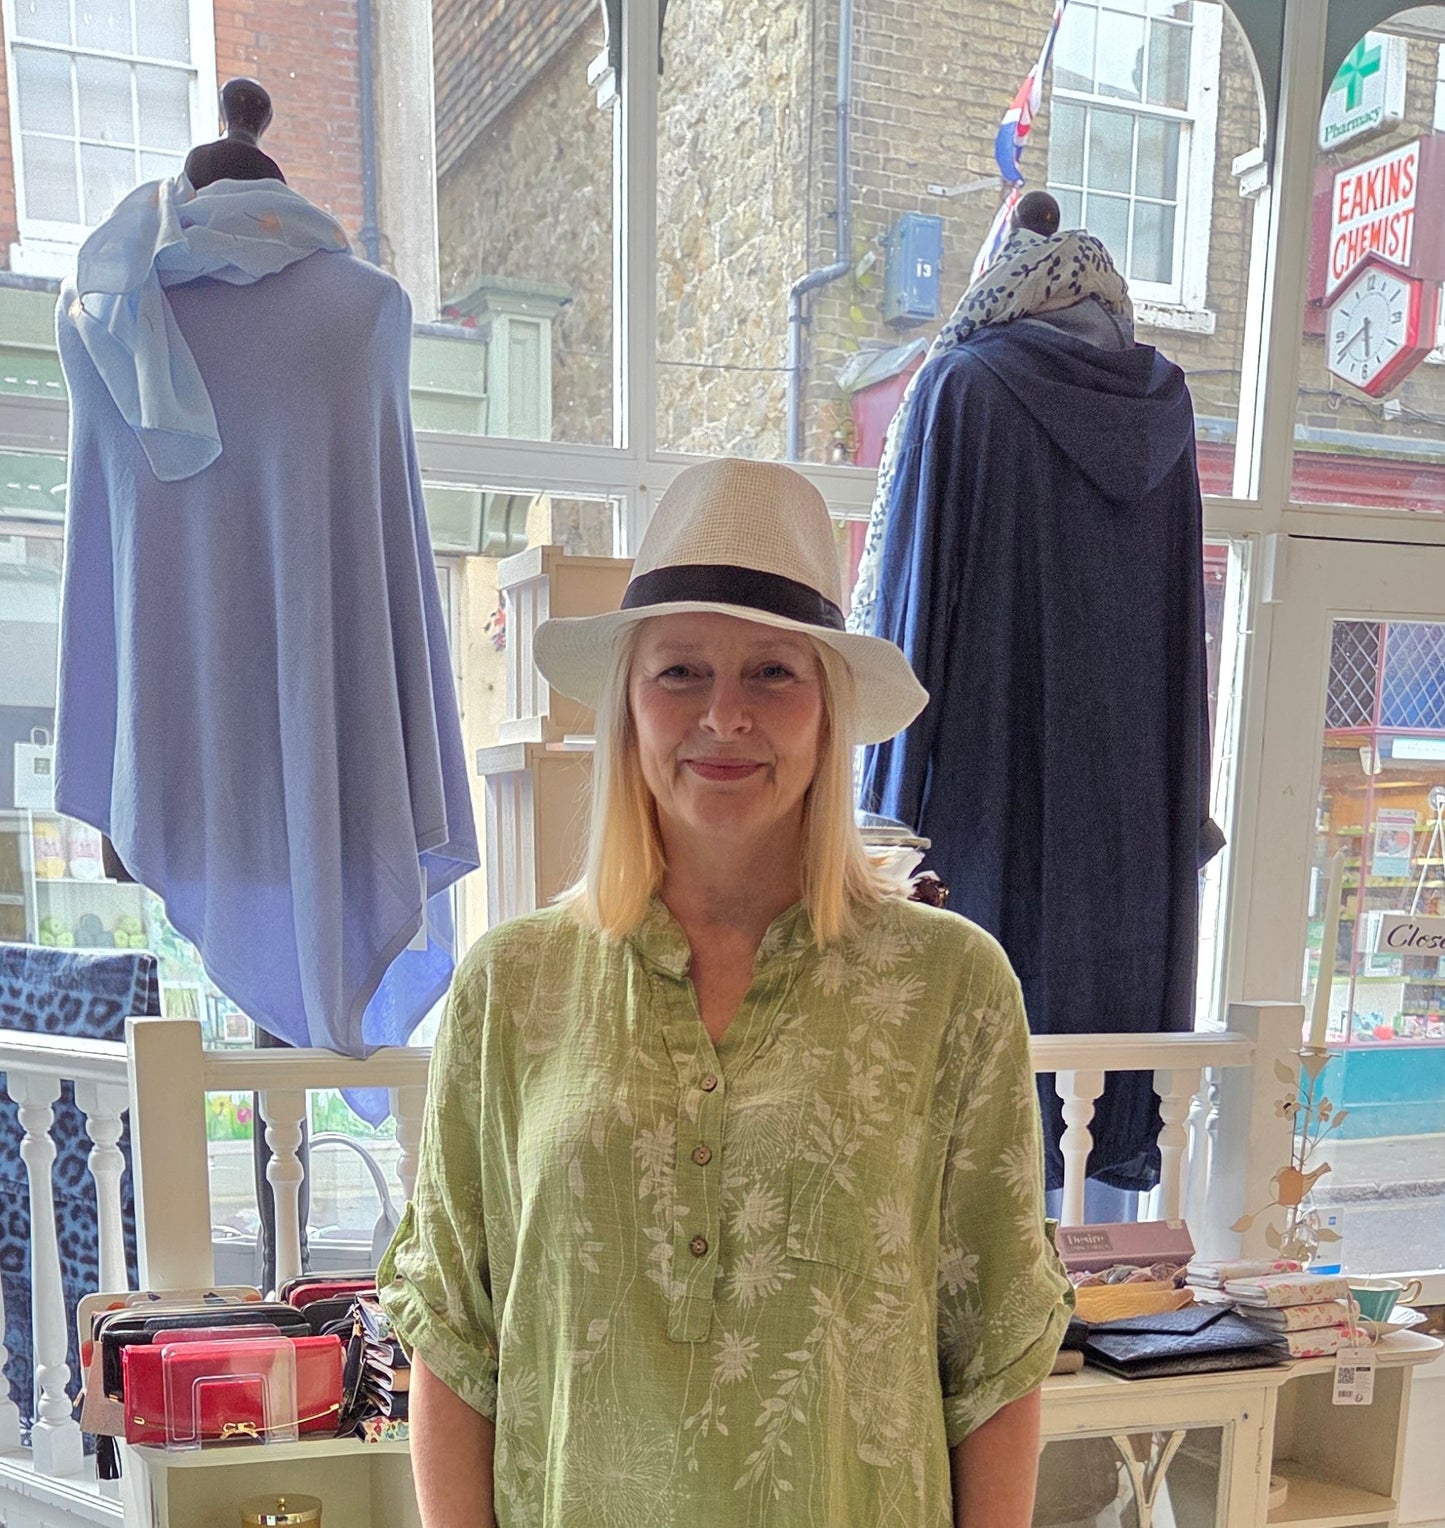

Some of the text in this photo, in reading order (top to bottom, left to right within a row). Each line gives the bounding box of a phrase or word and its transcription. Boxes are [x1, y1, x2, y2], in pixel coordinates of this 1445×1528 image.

[1324, 106, 1382, 143] Pharmacy
[1338, 154, 1415, 225] EAKINS
[916, 258, 932, 278] 13
[1333, 207, 1416, 280] CHEMIST
